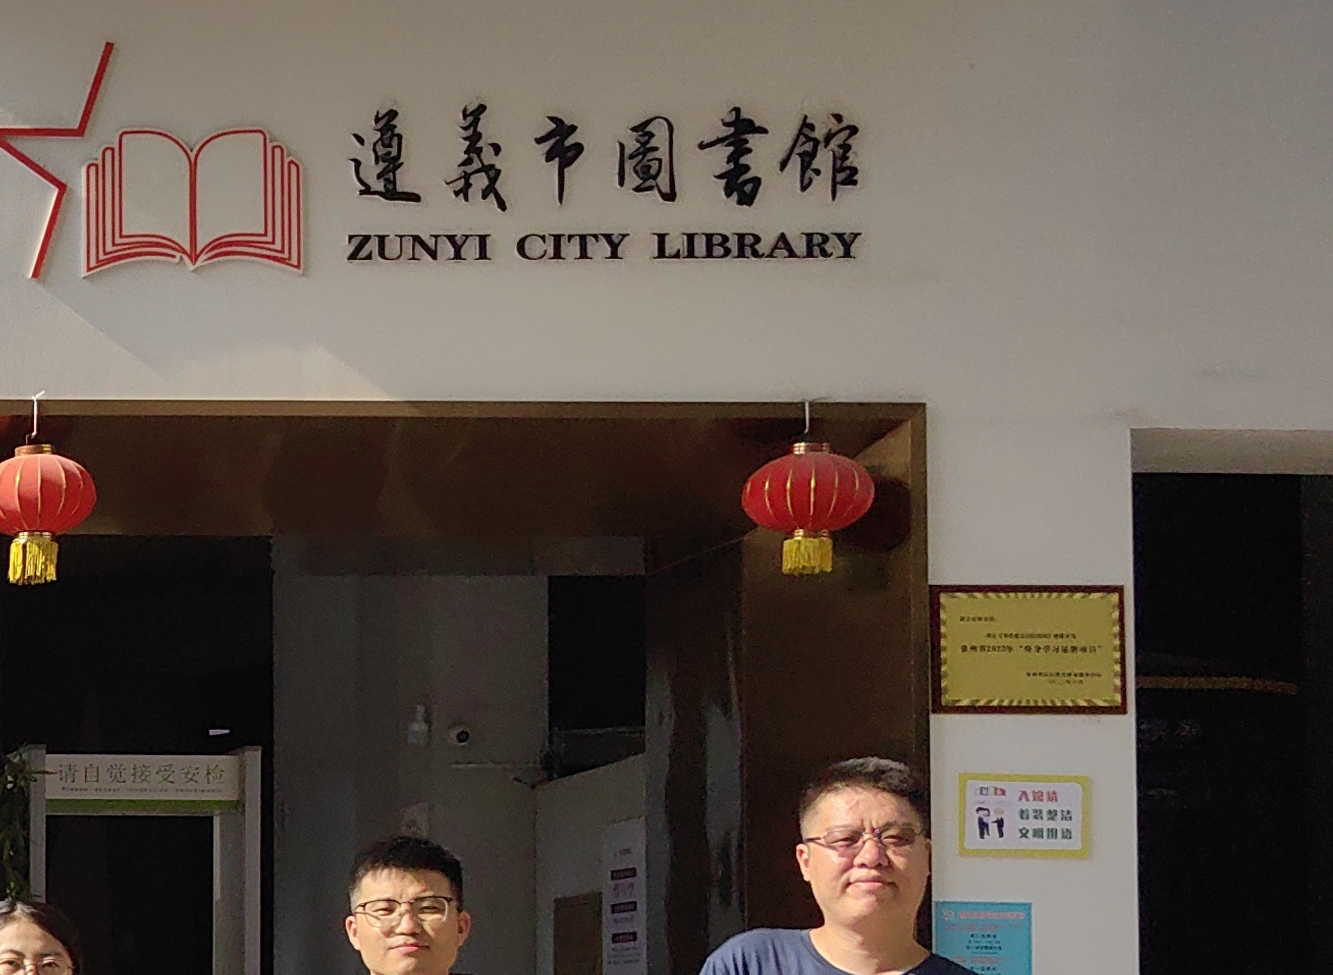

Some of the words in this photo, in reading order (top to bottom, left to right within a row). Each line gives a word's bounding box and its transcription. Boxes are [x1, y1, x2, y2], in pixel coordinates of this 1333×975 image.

[348, 103, 861, 213] 遵義市圖書館
[346, 231, 492, 262] ZUNYI
[516, 231, 630, 262] CITY
[651, 231, 862, 261] LIBRARY
[58, 762, 226, 785] 请自觉接受安检
